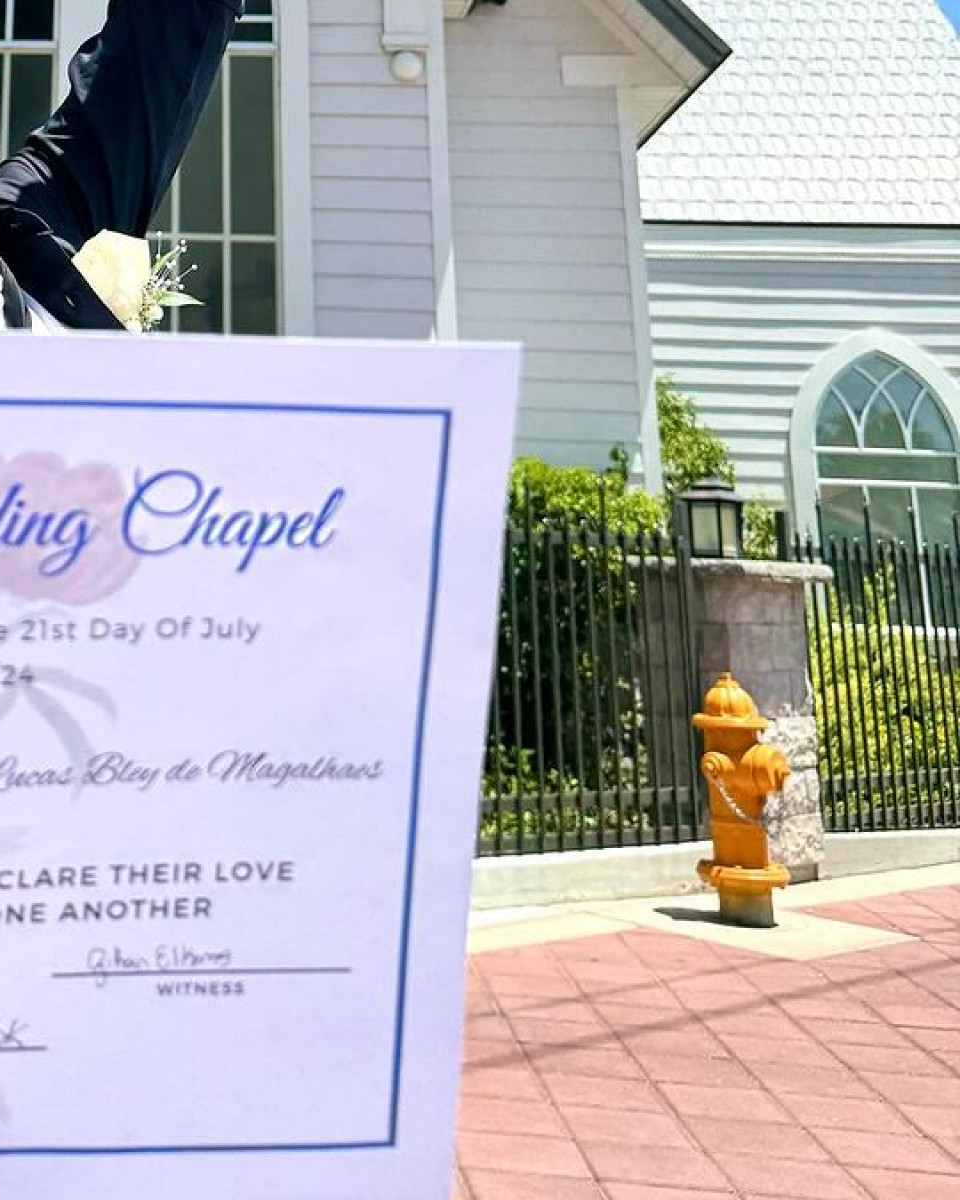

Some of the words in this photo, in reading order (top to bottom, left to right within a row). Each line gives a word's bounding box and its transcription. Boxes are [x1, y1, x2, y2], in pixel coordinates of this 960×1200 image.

[120, 465, 346, 573] Chapel
[20, 618, 77, 642] 21st
[89, 617, 146, 645] Day
[157, 616, 192, 639] Of
[201, 615, 263, 645] July
[83, 751, 161, 791] Bley
[164, 757, 202, 781] de
[109, 862, 203, 885] THEIR
[215, 860, 295, 883] LOVE
[57, 897, 213, 922] ANOTHER
[155, 978, 246, 998] WITNESS
